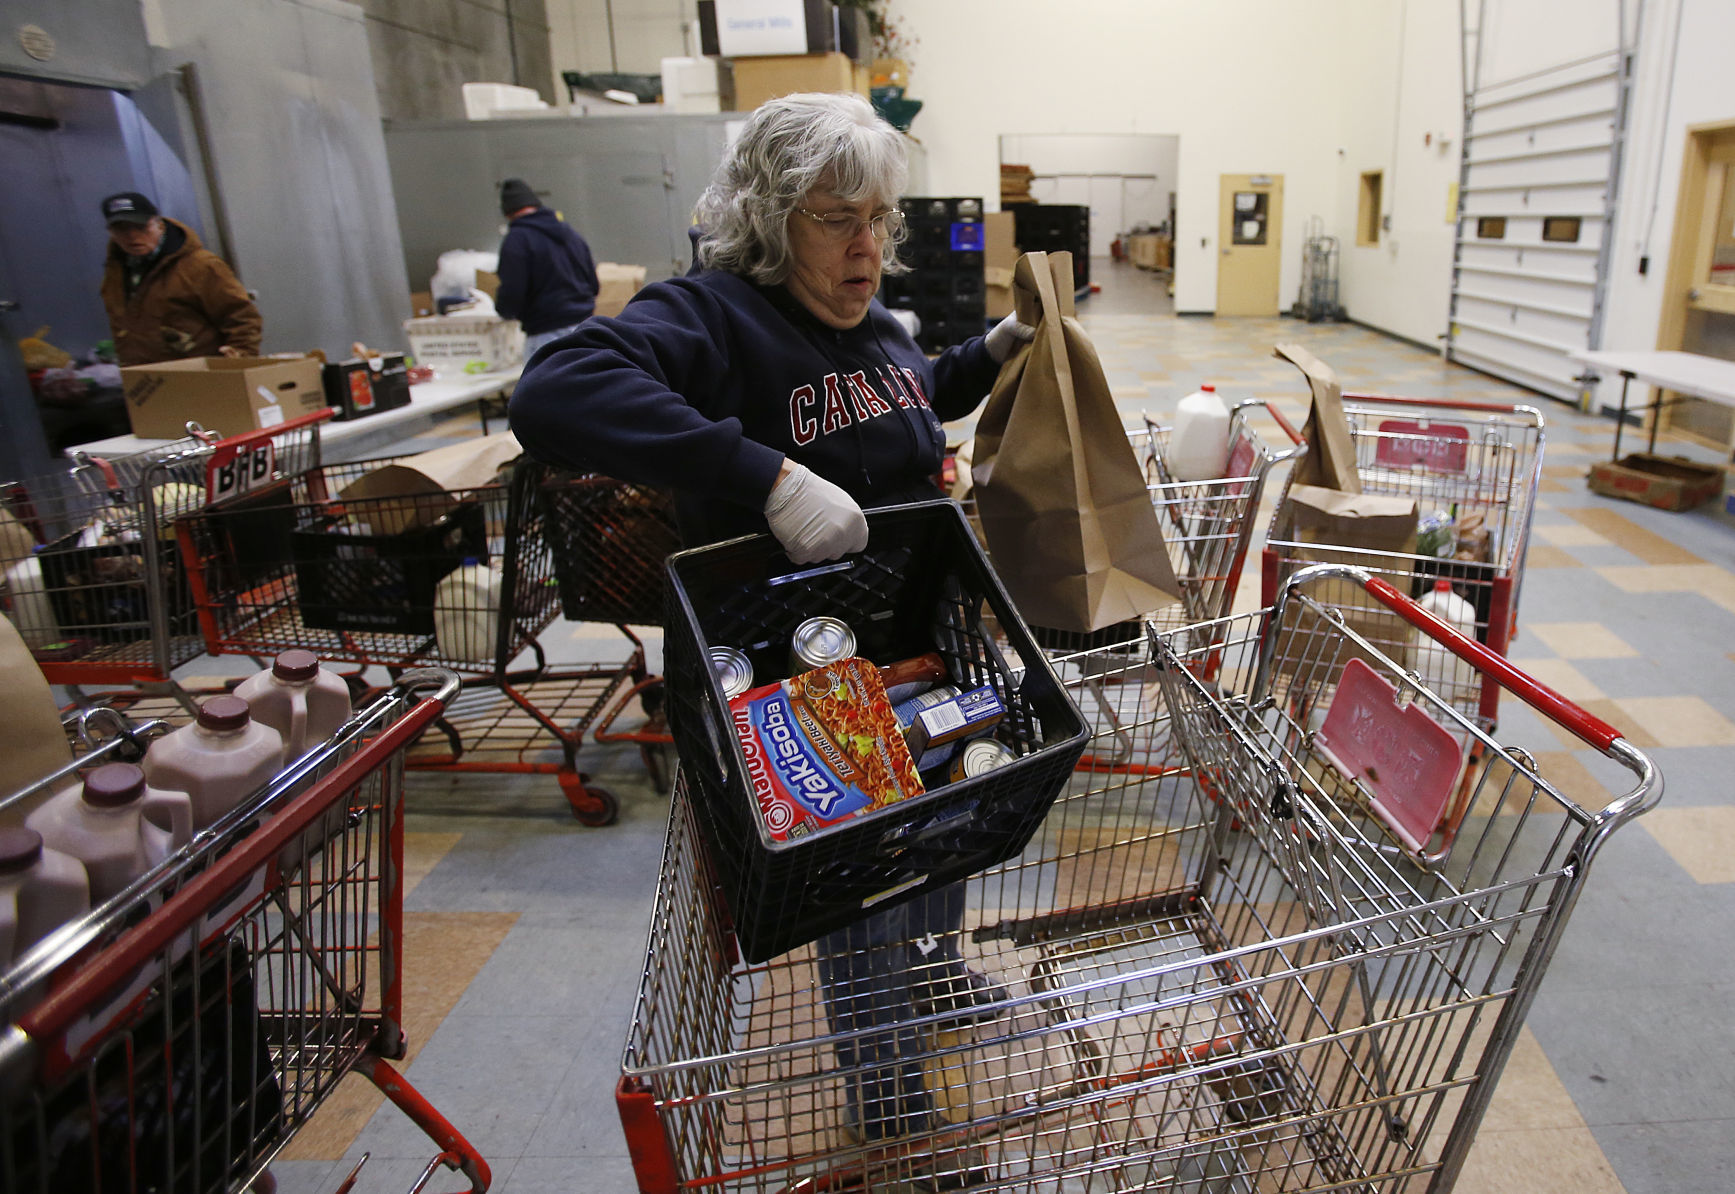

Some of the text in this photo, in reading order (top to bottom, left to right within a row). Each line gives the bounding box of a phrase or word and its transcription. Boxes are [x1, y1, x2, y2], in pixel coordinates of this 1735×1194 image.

[450, 341, 478, 349] STATES
[803, 717, 823, 741] Beef
[766, 701, 841, 813] Yakisoba
[814, 734, 855, 779] Teriyaki
